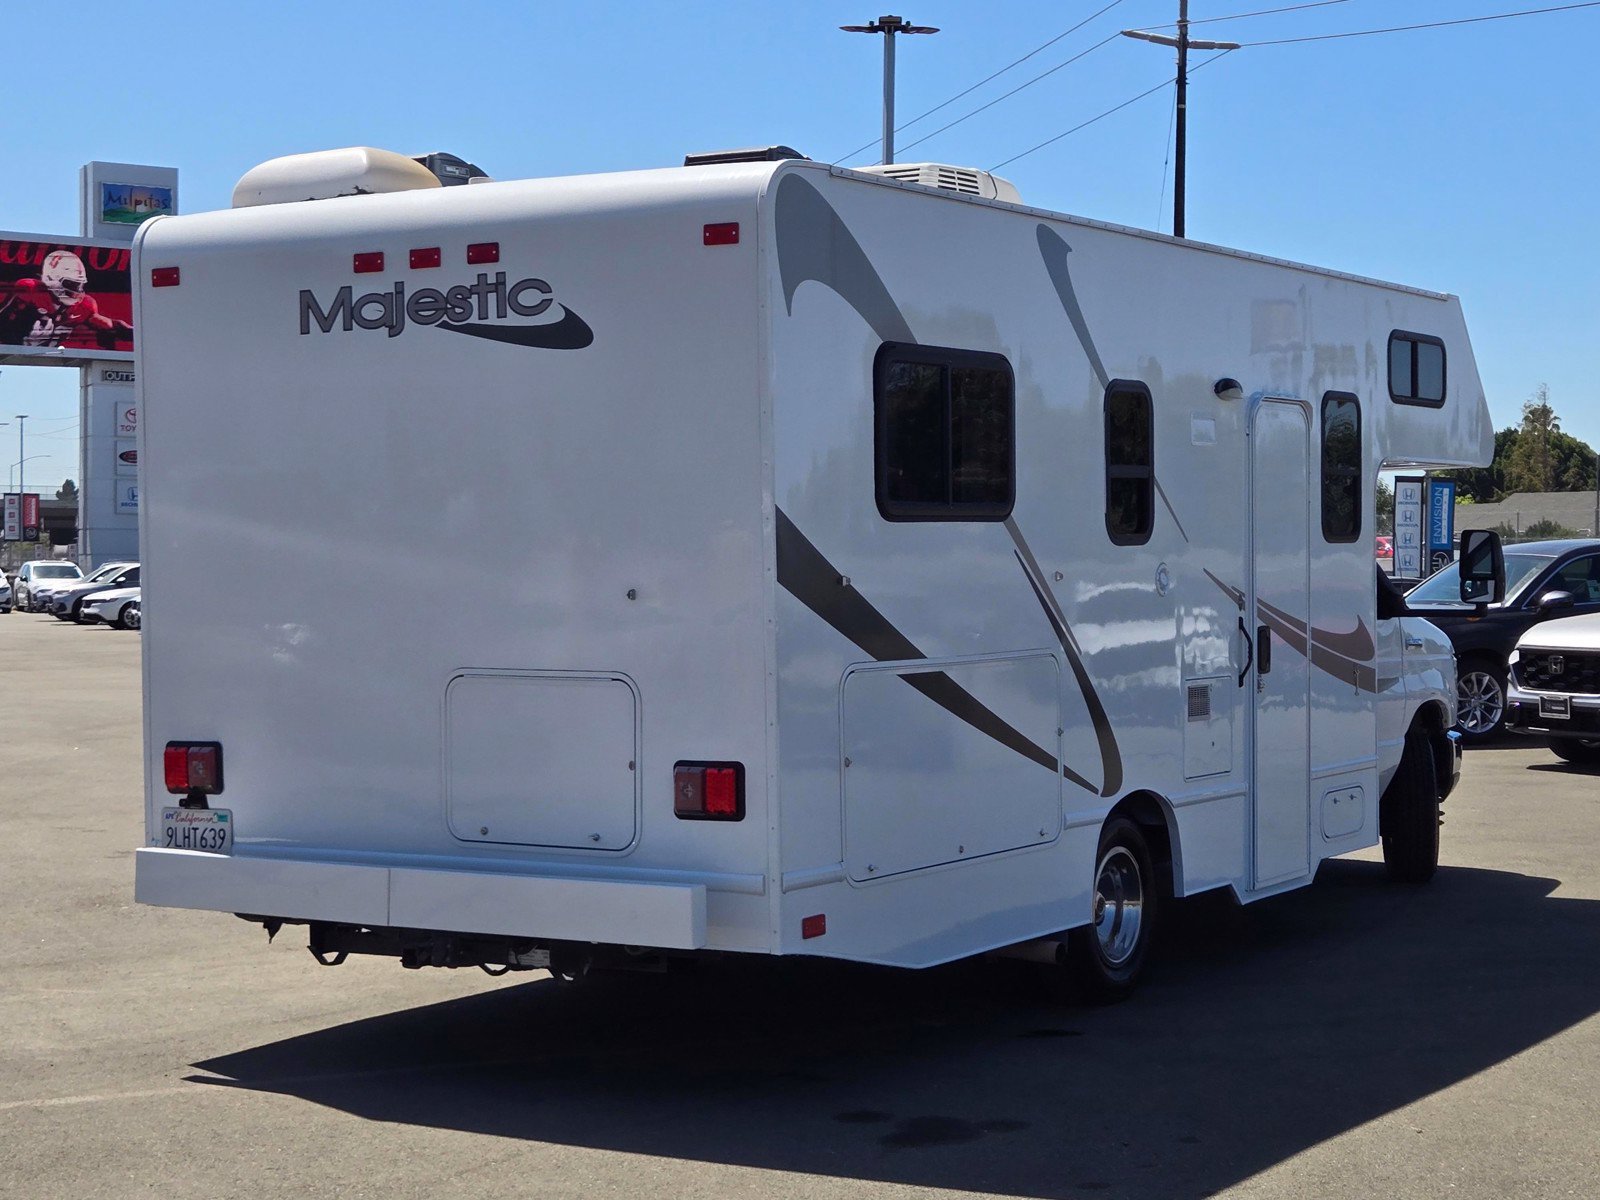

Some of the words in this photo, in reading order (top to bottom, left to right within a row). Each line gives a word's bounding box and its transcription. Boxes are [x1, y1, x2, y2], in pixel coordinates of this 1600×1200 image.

[107, 187, 170, 212] Milpitas
[299, 271, 554, 338] Majestic
[1433, 487, 1443, 544] ENVISION
[166, 826, 226, 850] 9LHT639
